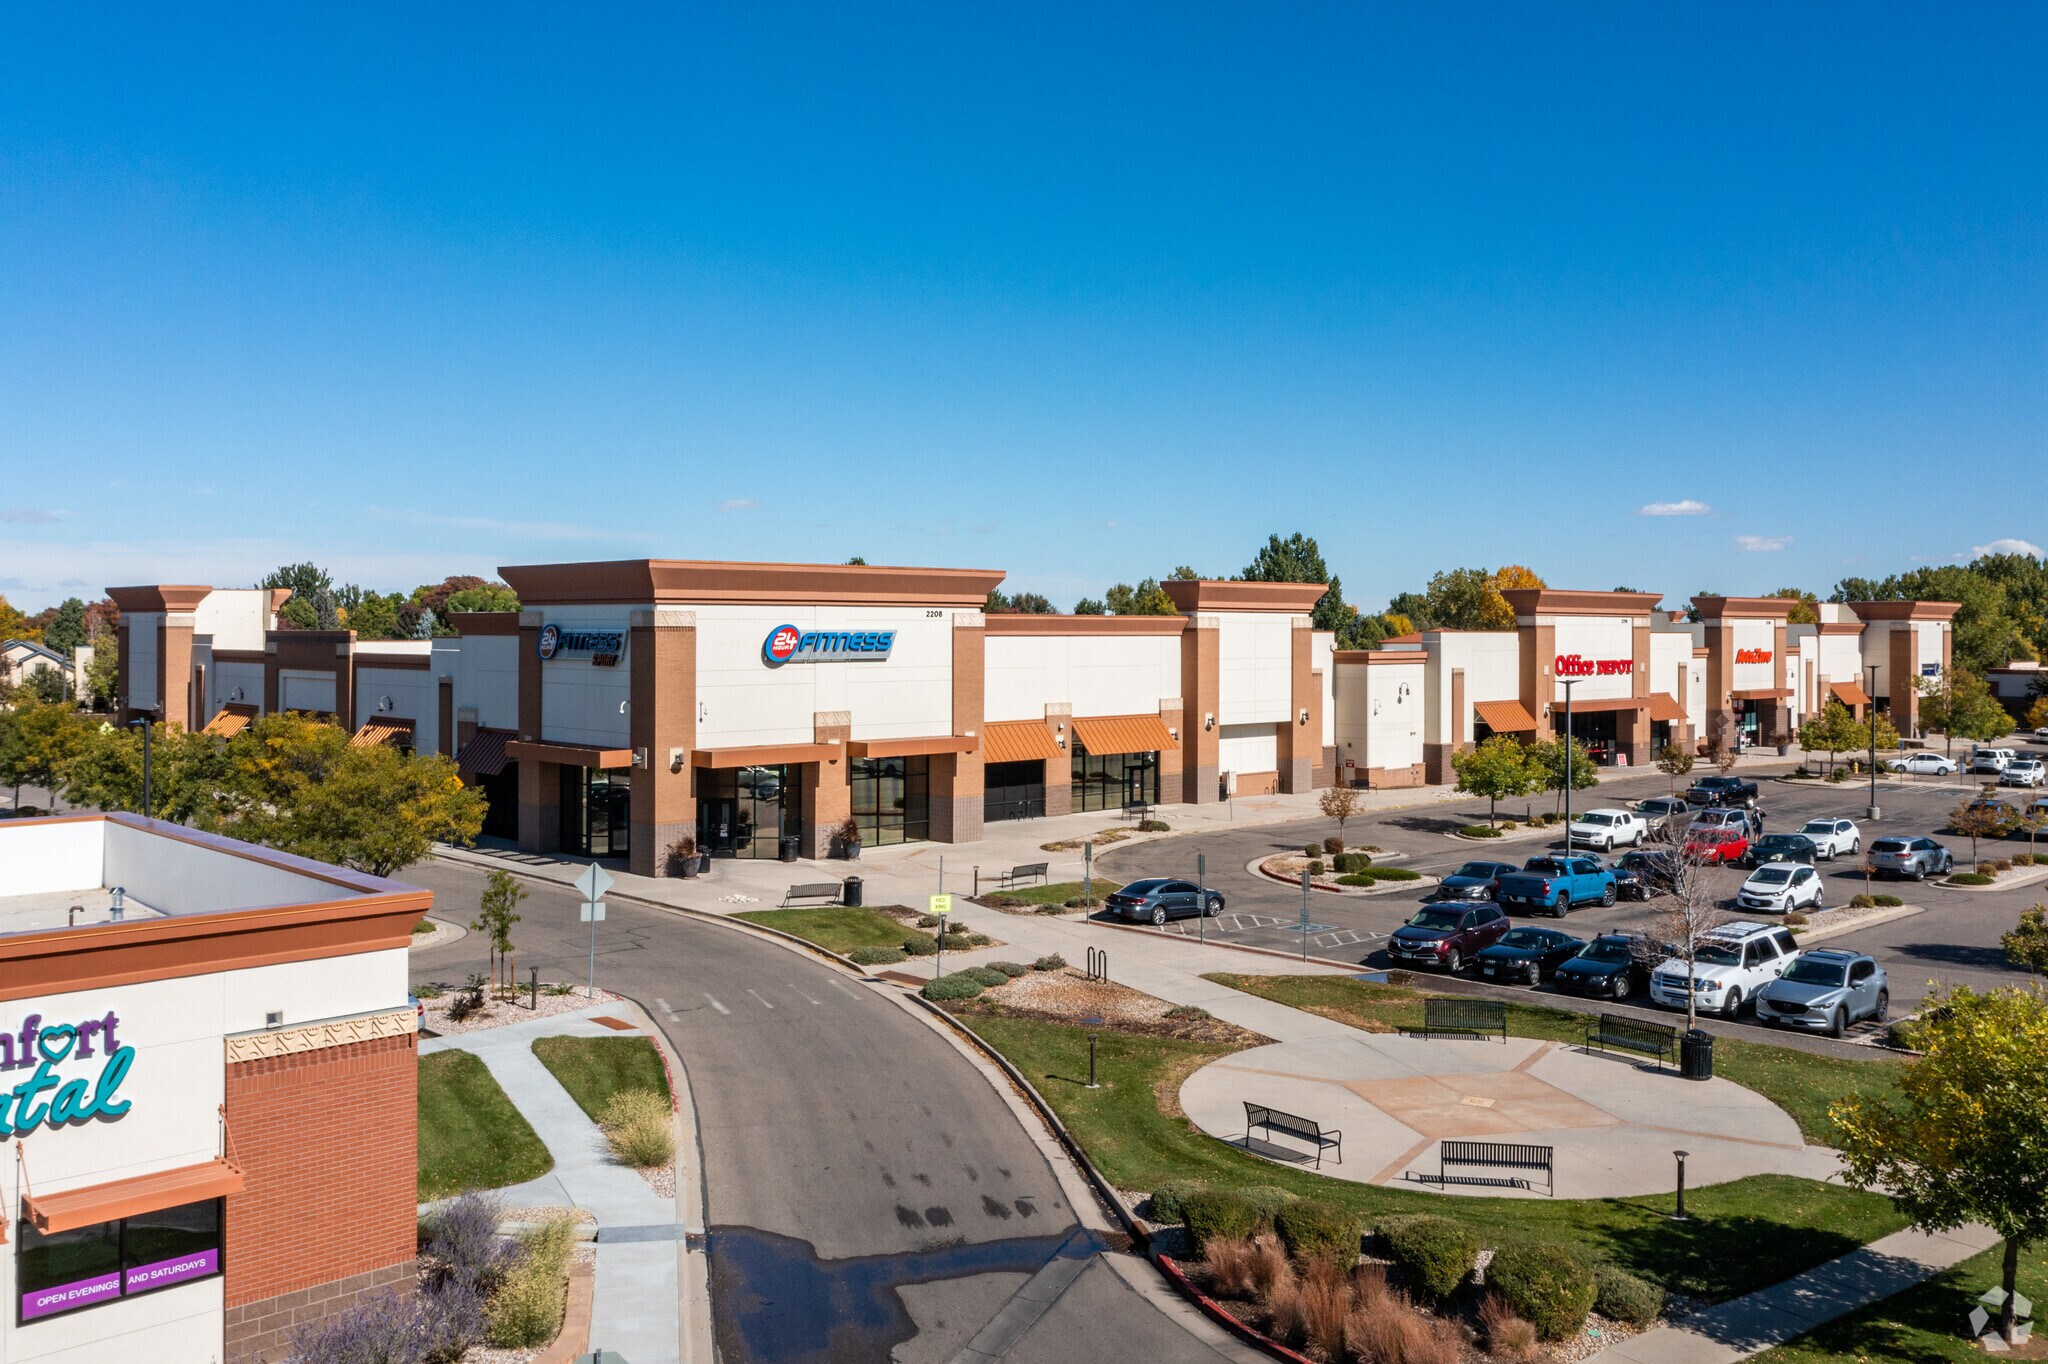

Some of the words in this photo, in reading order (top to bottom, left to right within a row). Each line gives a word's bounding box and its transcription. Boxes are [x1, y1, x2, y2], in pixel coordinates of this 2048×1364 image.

[541, 632, 556, 650] 24
[558, 632, 624, 651] FITNESS
[774, 631, 798, 650] 24
[799, 632, 894, 651] FITNESS
[592, 653, 618, 666] SPORT
[1555, 654, 1595, 676] Office
[1596, 659, 1633, 675] DEPOT
[37, 1293, 67, 1307] OPEN
[69, 1280, 120, 1299] EVENINGS
[128, 1273, 149, 1285] AND
[150, 1259, 206, 1279] SATURDAYS
